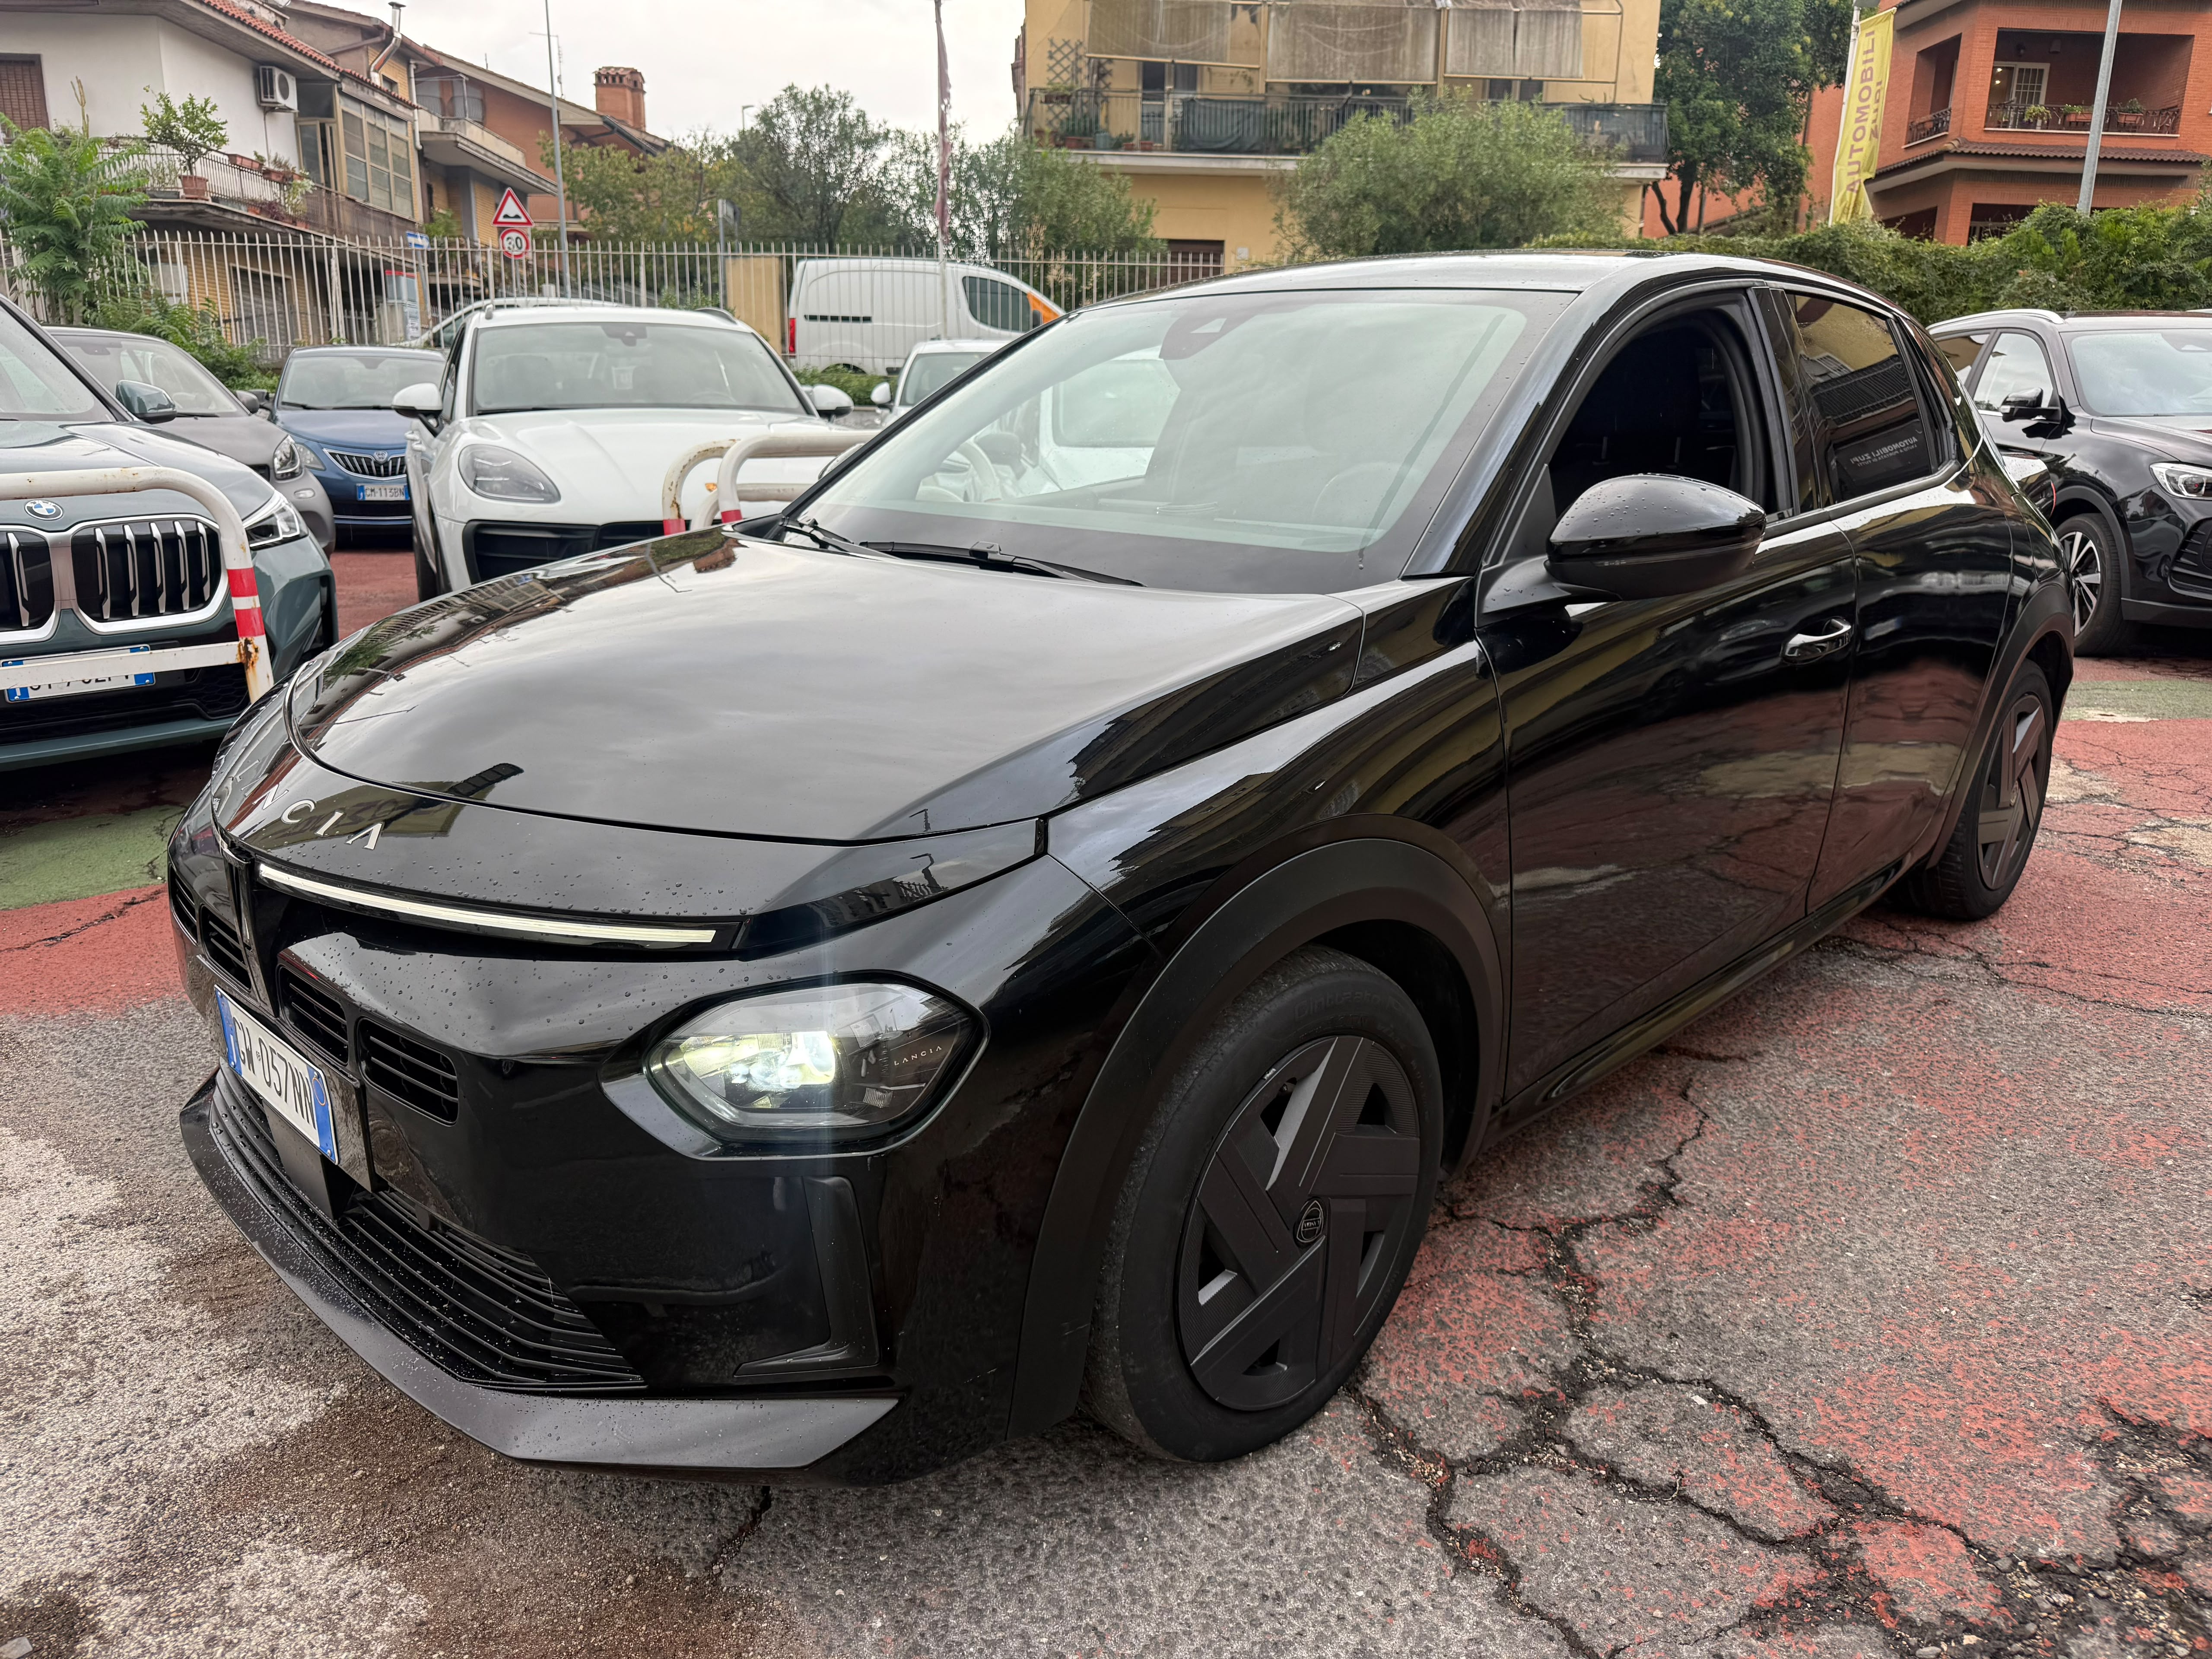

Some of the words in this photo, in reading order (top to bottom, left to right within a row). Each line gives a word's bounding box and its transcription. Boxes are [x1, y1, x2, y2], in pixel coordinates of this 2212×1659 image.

[1846, 30, 1875, 194] AUTOMOBILI
[506, 236, 522, 251] 30
[232, 1017, 255, 1075] GW
[259, 1037, 316, 1130] 057NN
[894, 1046, 942, 1066] LANCIA
